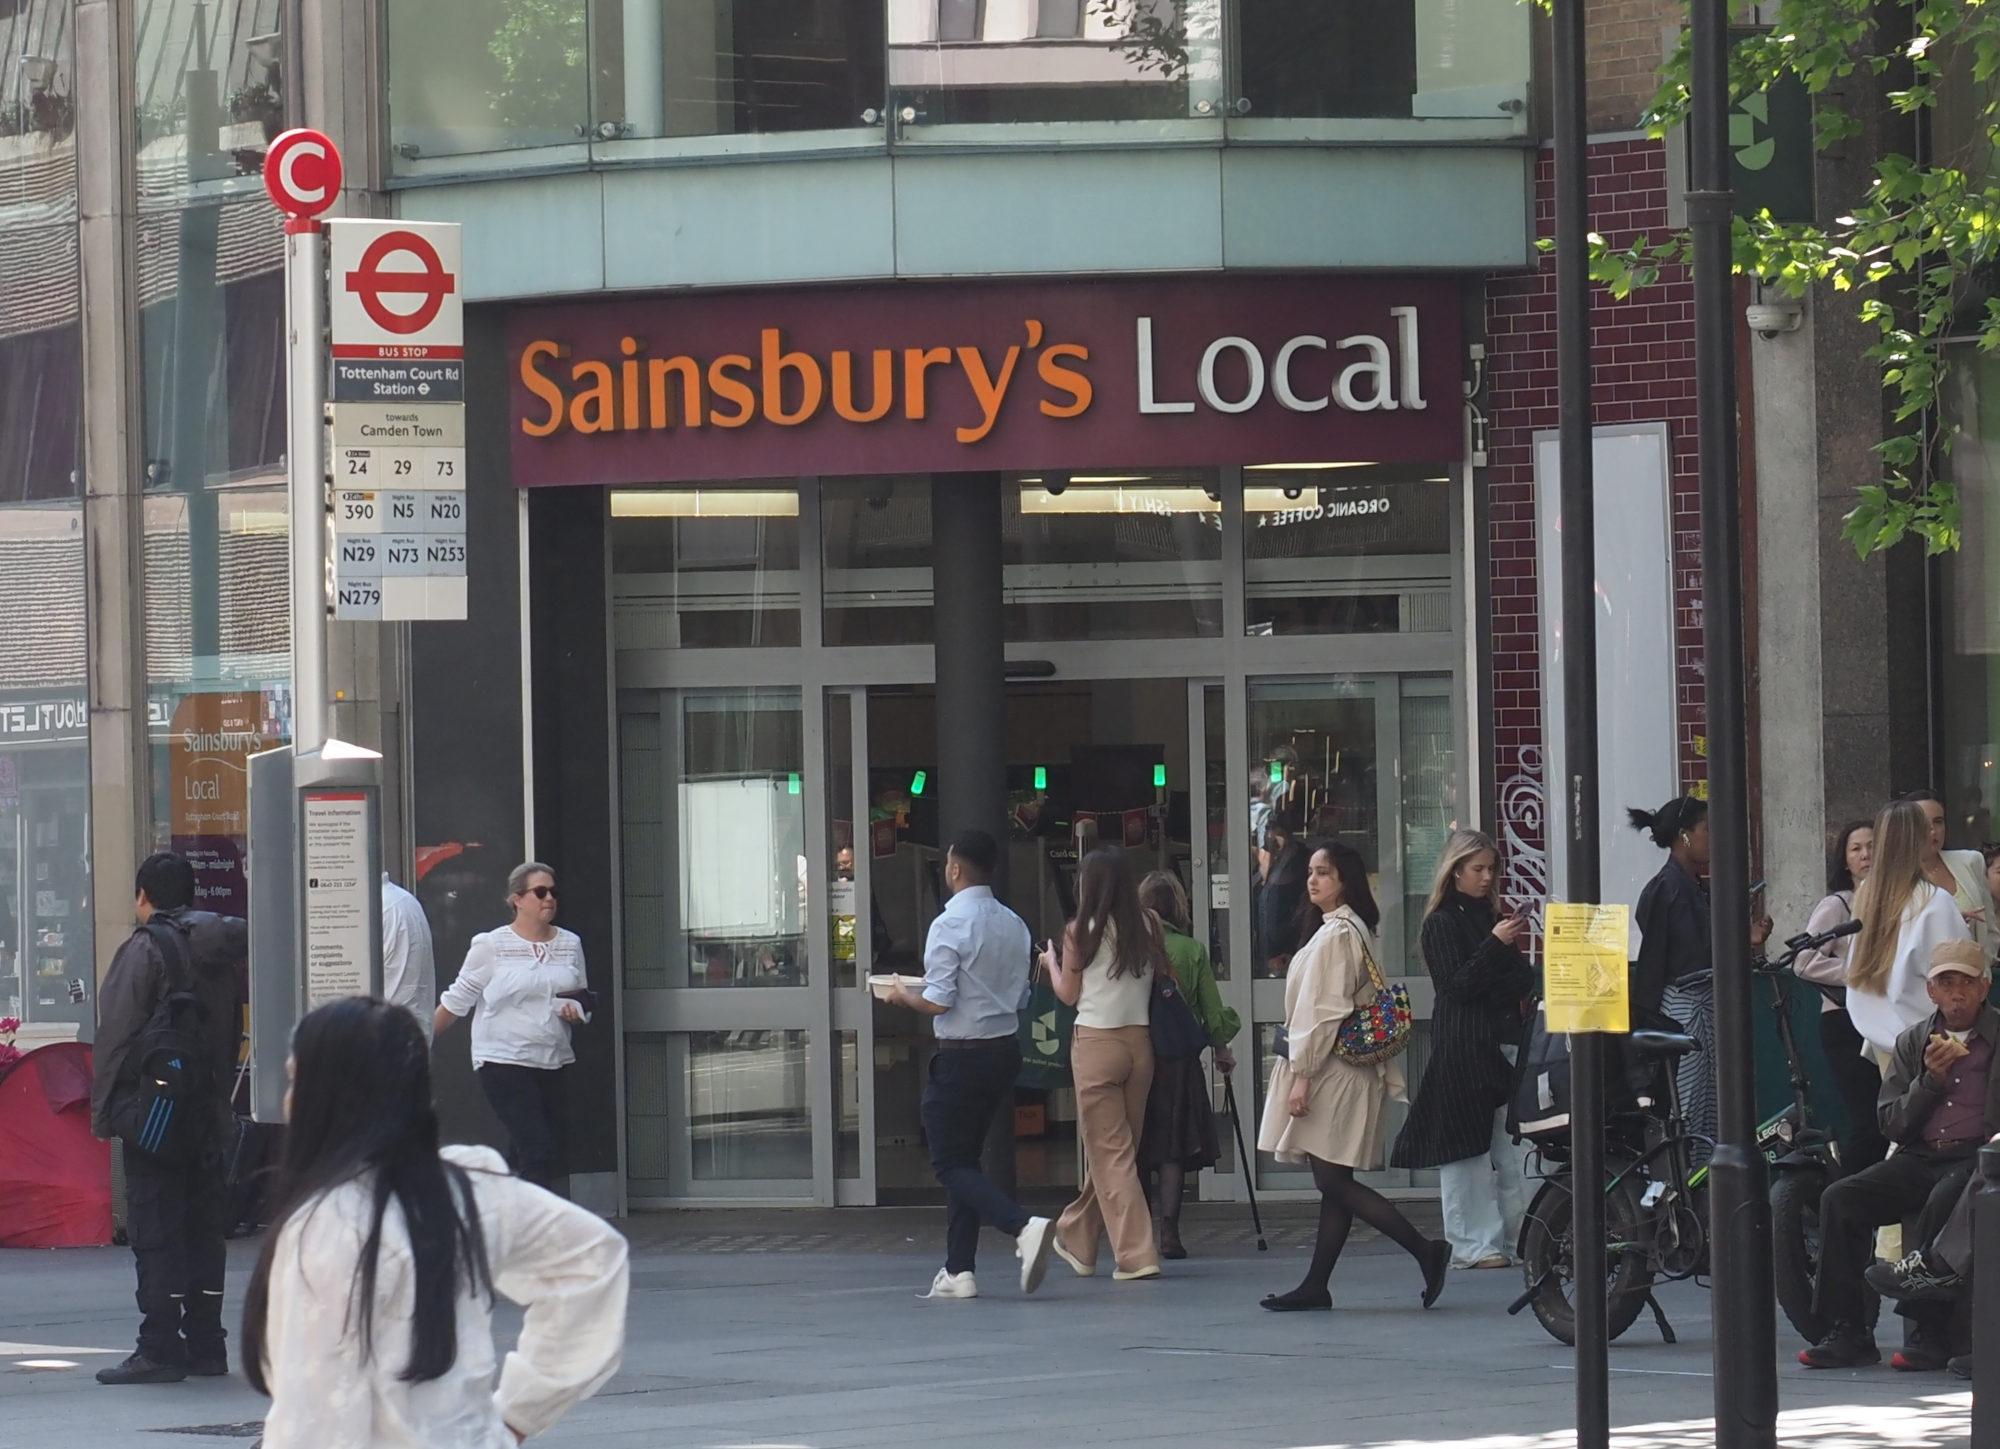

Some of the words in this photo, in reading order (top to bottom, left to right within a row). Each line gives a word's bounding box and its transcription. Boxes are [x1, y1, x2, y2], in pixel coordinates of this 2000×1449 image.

[279, 141, 326, 203] C
[378, 347, 399, 356] BUS
[402, 347, 428, 357] STOP
[339, 366, 407, 379] Tottenham
[409, 367, 443, 380] Court
[445, 368, 459, 380] Rd
[520, 319, 1094, 444] Sainsbury's
[1136, 305, 1427, 414] Local
[373, 382, 415, 395] Station
[385, 413, 419, 421] towards
[360, 424, 409, 437] Camden
[413, 425, 442, 437] Town
[348, 459, 367, 474] 24
[393, 460, 412, 475] 29
[437, 461, 454, 476] 73
[345, 504, 374, 520] 390
[393, 503, 415, 518] N5
[431, 503, 461, 519] N20
[343, 546, 375, 561] N29
[388, 548, 419, 563] N73
[427, 546, 465, 562] N253
[339, 590, 381, 605] N279
[185, 773, 220, 800] Local
